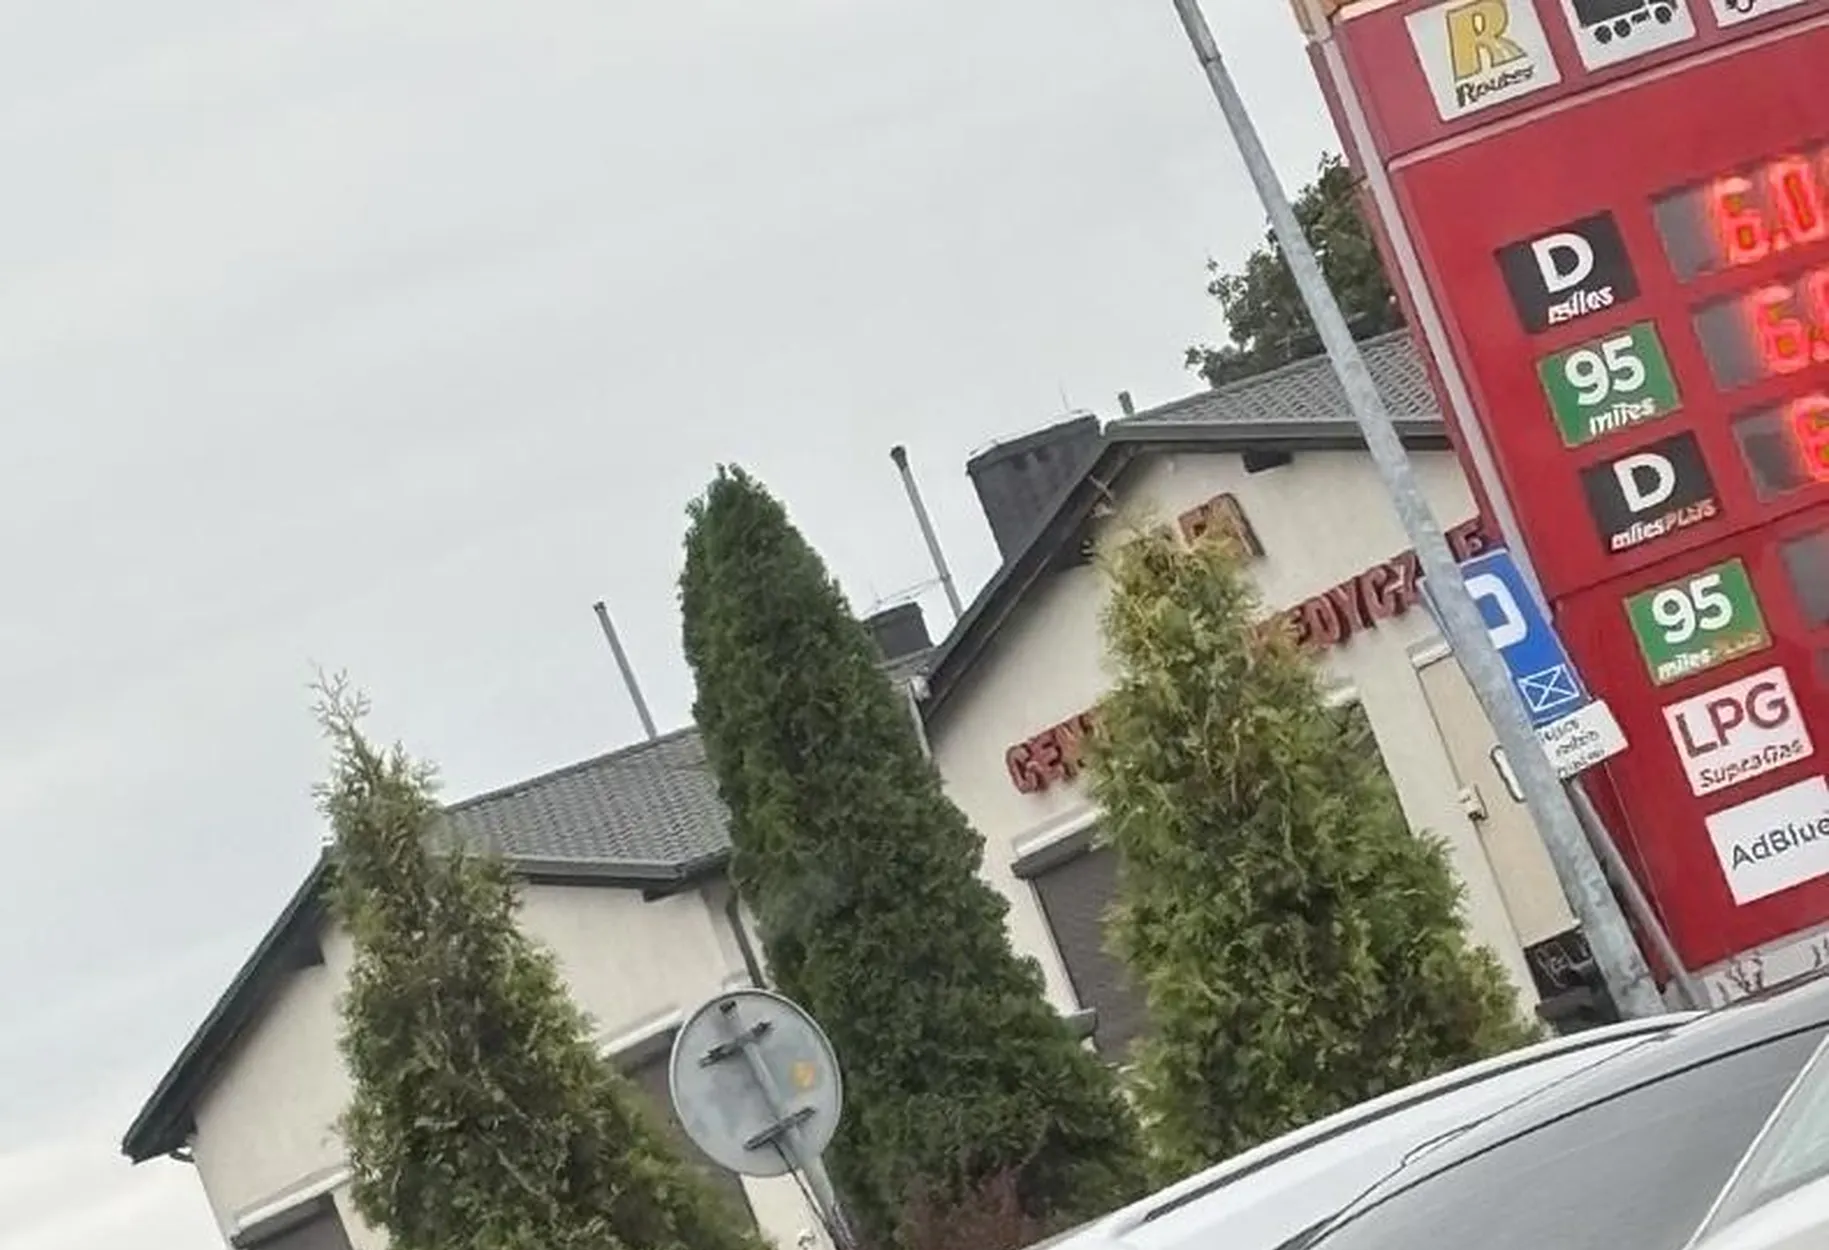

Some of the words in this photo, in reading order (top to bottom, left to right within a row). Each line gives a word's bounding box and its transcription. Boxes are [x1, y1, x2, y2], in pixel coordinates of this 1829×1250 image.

[1532, 232, 1594, 293] D
[1564, 335, 1645, 405] 95
[1589, 397, 1655, 436] miles
[1613, 453, 1676, 513] D
[1651, 573, 1733, 644] 95
[1675, 682, 1790, 758] LPG
[1732, 817, 1829, 870] AdBlue
